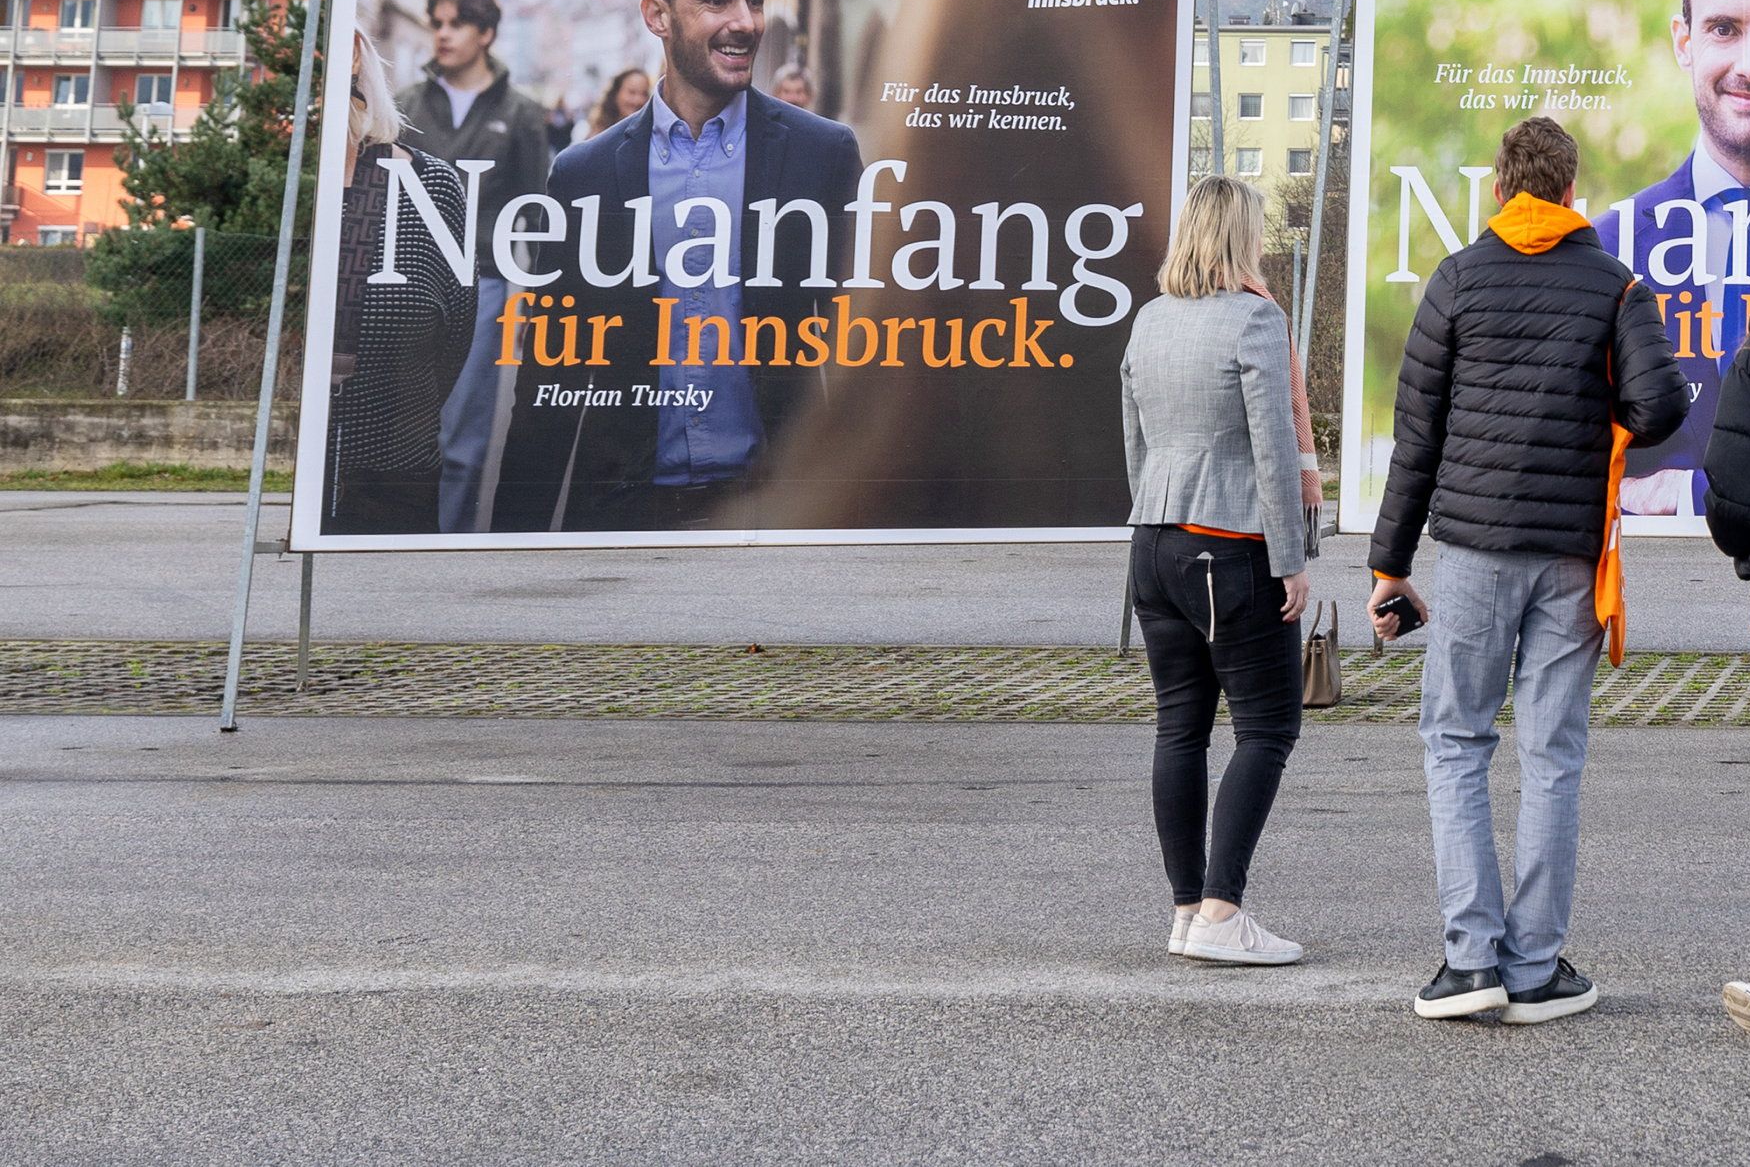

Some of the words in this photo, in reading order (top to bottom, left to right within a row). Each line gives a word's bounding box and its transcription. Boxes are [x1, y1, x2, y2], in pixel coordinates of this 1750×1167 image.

[1434, 63, 1473, 83] Für
[1478, 63, 1515, 83] das
[1521, 64, 1633, 88] Innsbruck,
[880, 82, 920, 102] Für
[924, 83, 961, 103] das
[966, 84, 1075, 110] Innsbruck,
[1459, 89, 1496, 109] das
[1503, 89, 1538, 110] wir
[1544, 89, 1612, 110] lieben.
[905, 107, 942, 128] das
[948, 109, 984, 129] wir
[988, 109, 1067, 131] kennen.
[366, 158, 1144, 328] Neuanfang
[494, 293, 623, 367] für
[649, 295, 1075, 368] Innsbruck.
[1656, 291, 1726, 359] it
[533, 384, 622, 406] Florian
[631, 384, 713, 412] Tursky
